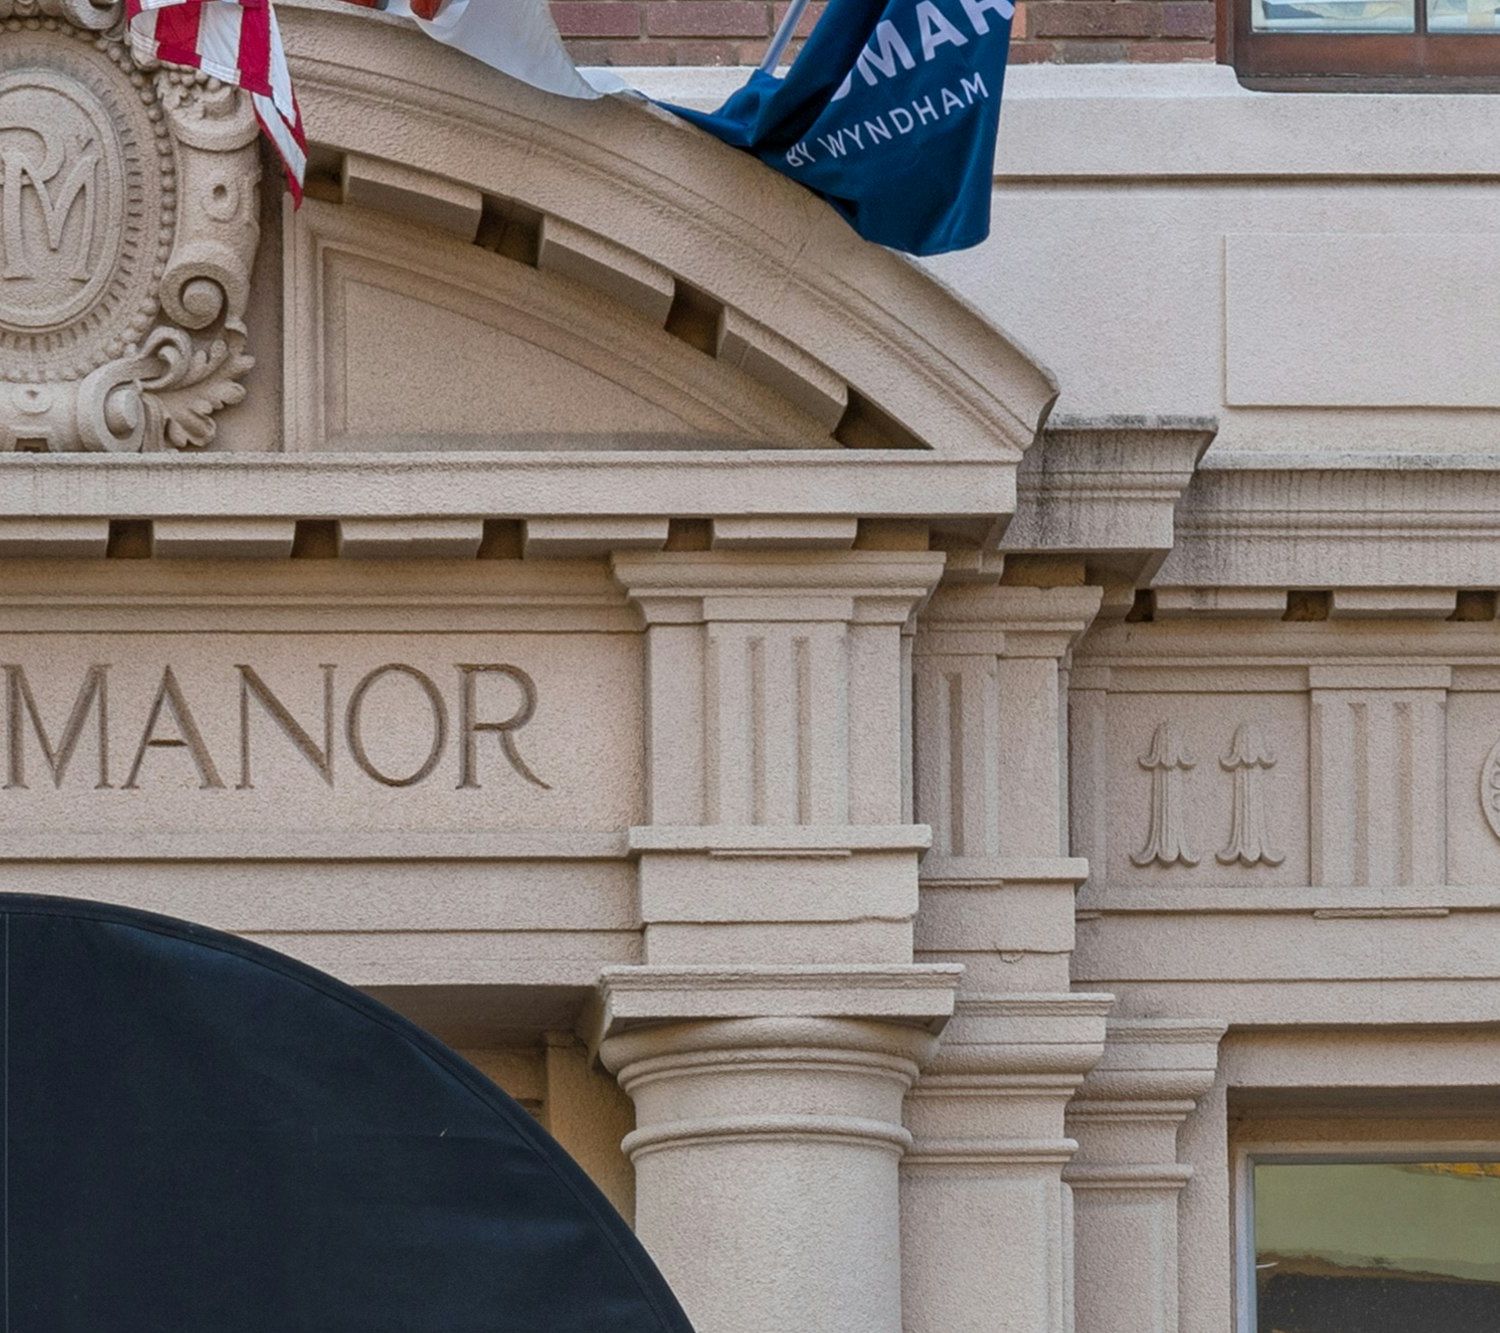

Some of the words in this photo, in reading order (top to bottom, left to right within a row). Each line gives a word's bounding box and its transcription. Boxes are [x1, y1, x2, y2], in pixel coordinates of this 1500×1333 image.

[786, 141, 816, 167] BY
[817, 72, 989, 158] WYNDHAM
[1, 662, 554, 791] MANOR
